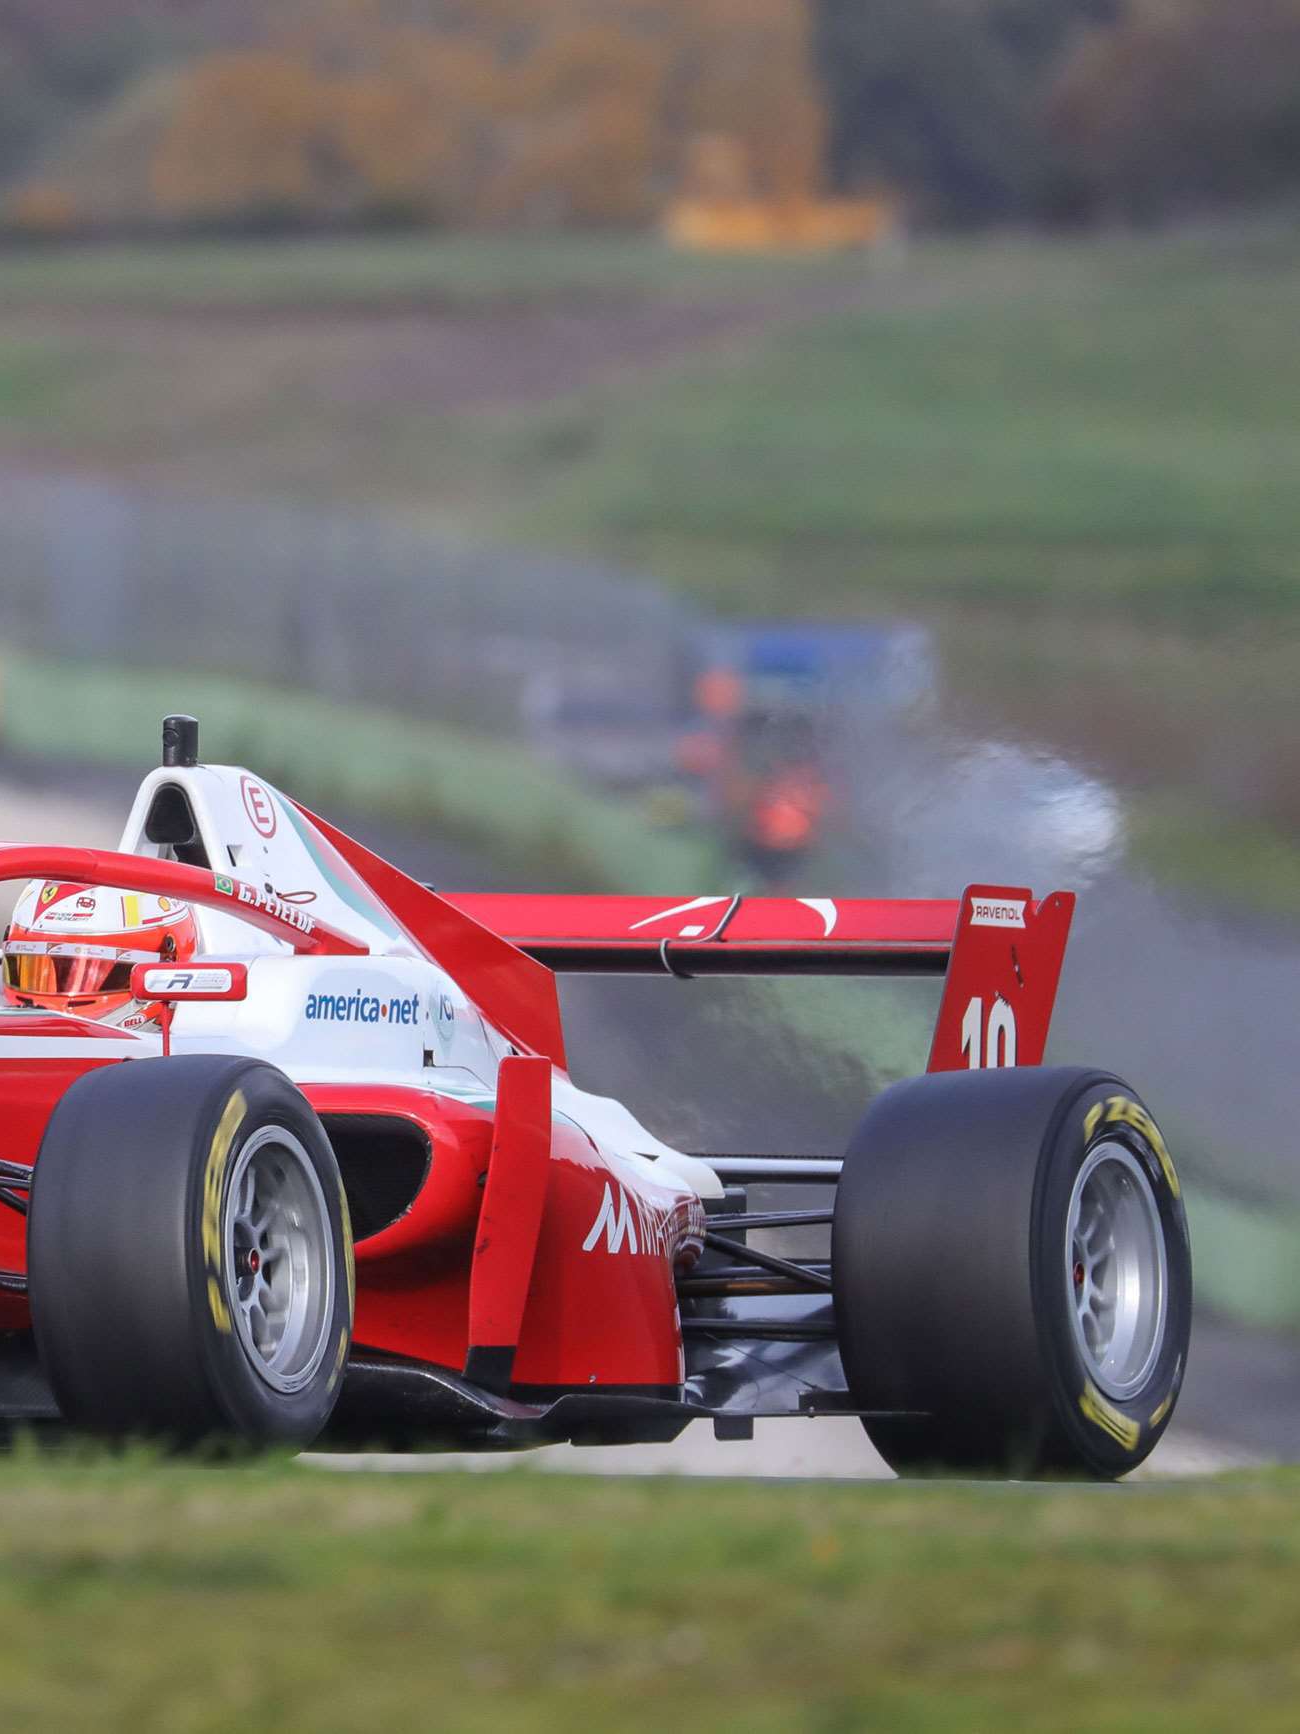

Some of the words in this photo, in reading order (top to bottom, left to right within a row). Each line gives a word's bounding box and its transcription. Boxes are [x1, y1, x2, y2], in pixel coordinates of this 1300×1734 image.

[975, 905, 1020, 921] RAVENOL
[123, 1017, 143, 1028] BELL
[961, 997, 1017, 1070] 10
